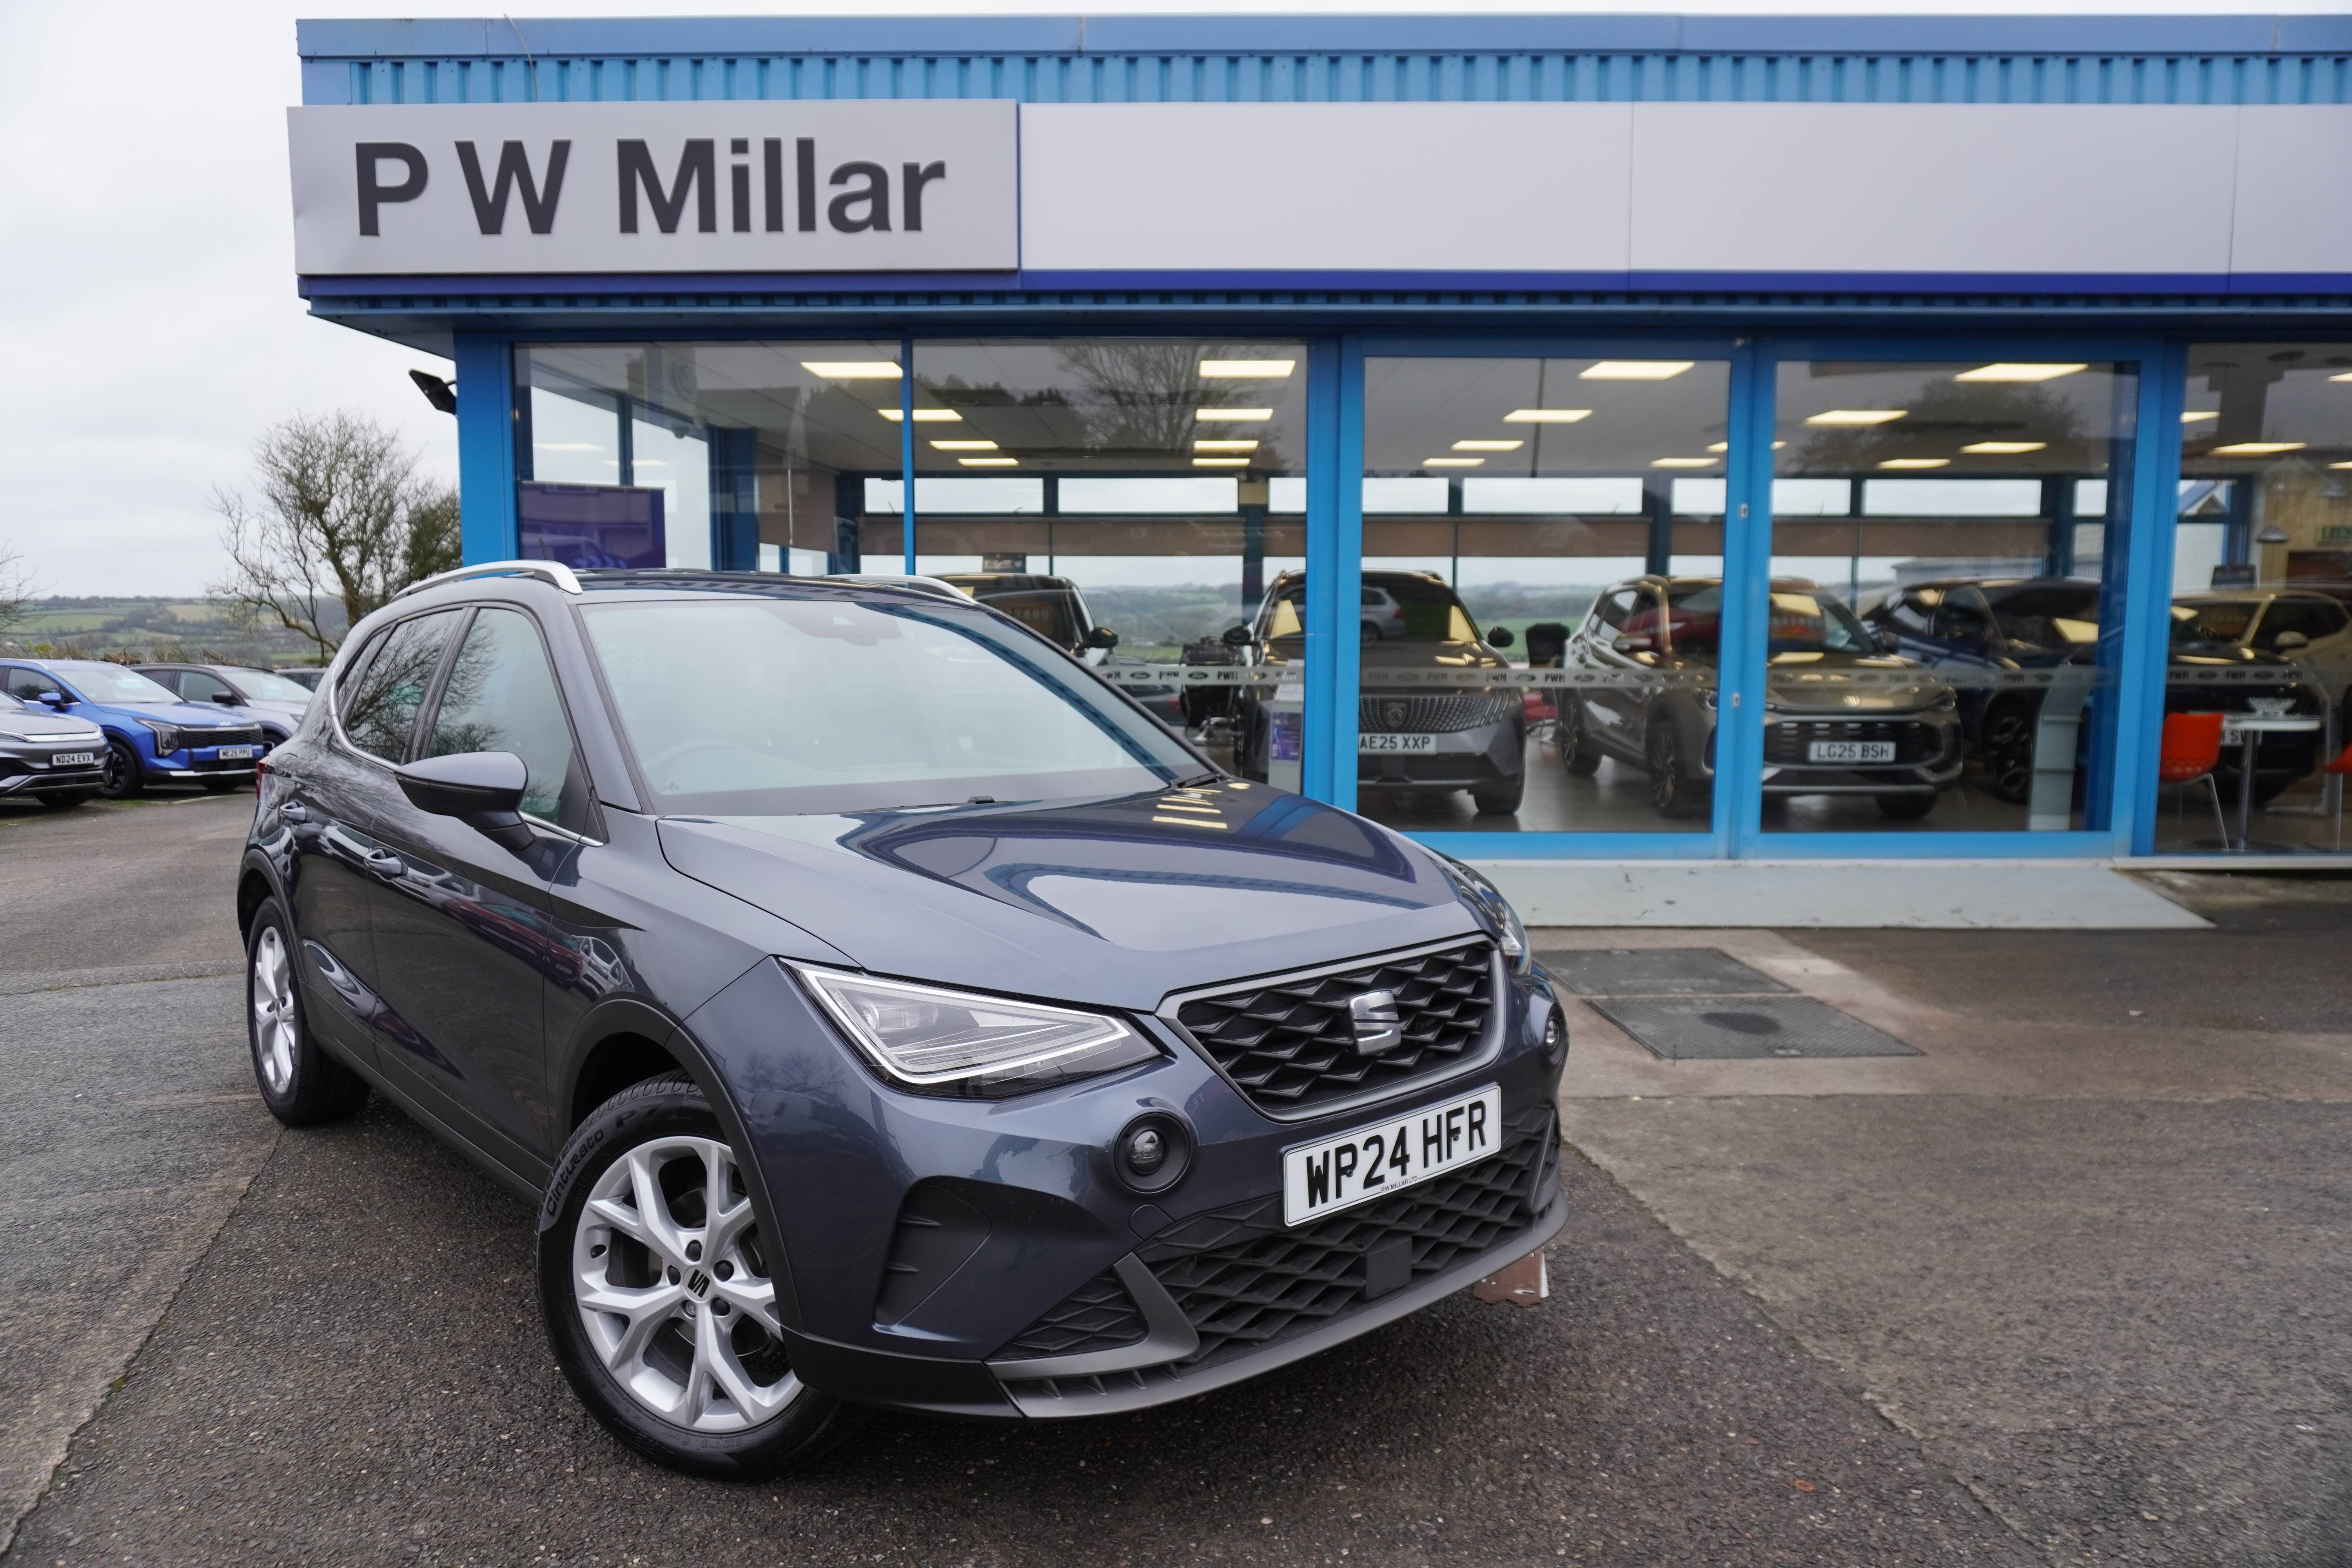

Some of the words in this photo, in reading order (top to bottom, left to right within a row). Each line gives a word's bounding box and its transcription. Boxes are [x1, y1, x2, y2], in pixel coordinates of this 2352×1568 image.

[355, 142, 429, 236] P
[454, 138, 572, 234] W
[616, 136, 946, 234] Millar
[1360, 736, 1397, 749] AE25
[1403, 736, 1430, 750] XXP
[1818, 744, 1856, 758] LG25
[1861, 744, 1889, 758] BSH
[56, 755, 75, 763] ND24
[1307, 1126, 1410, 1209] WP24
[1423, 1100, 1486, 1169] HFR
